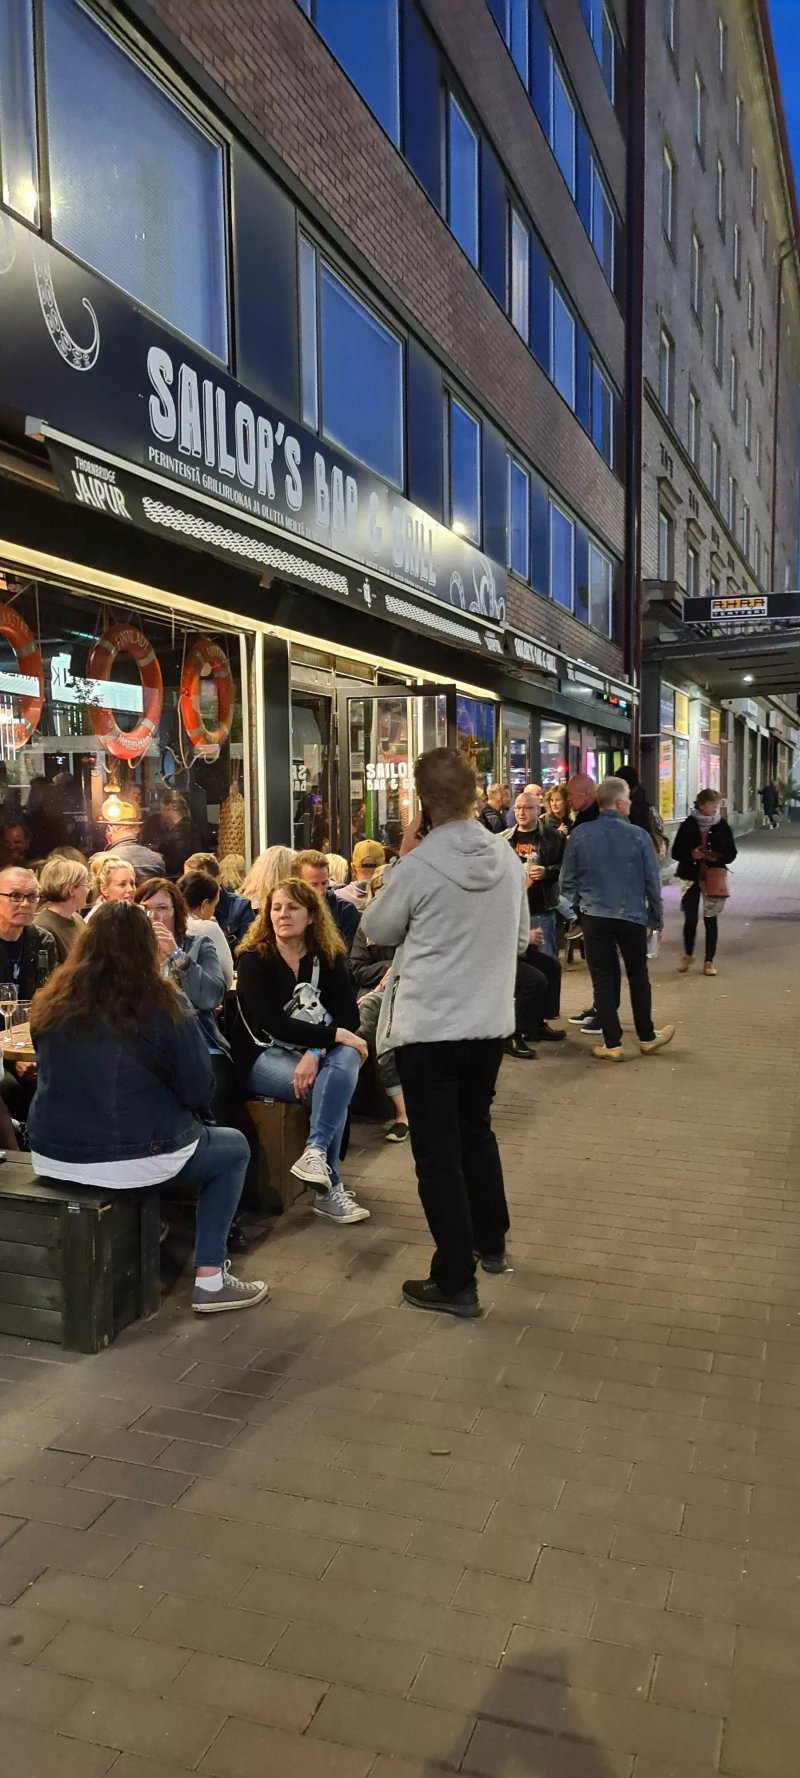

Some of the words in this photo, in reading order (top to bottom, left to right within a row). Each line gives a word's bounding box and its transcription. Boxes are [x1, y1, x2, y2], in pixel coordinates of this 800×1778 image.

[75, 456, 116, 484] THORNBRIDGE
[147, 346, 303, 511] SAILOR'S
[313, 451, 358, 540] BAR
[391, 506, 437, 587] GRILL
[148, 446, 201, 485] PERINTEISTÄ
[202, 473, 252, 511] GRILLIRUOKAA
[253, 499, 260, 515] JA
[261, 504, 284, 527] OLUTTA
[71, 470, 133, 520] JAIPUR
[366, 779, 386, 790] BAR
[390, 780, 398, 790] &
